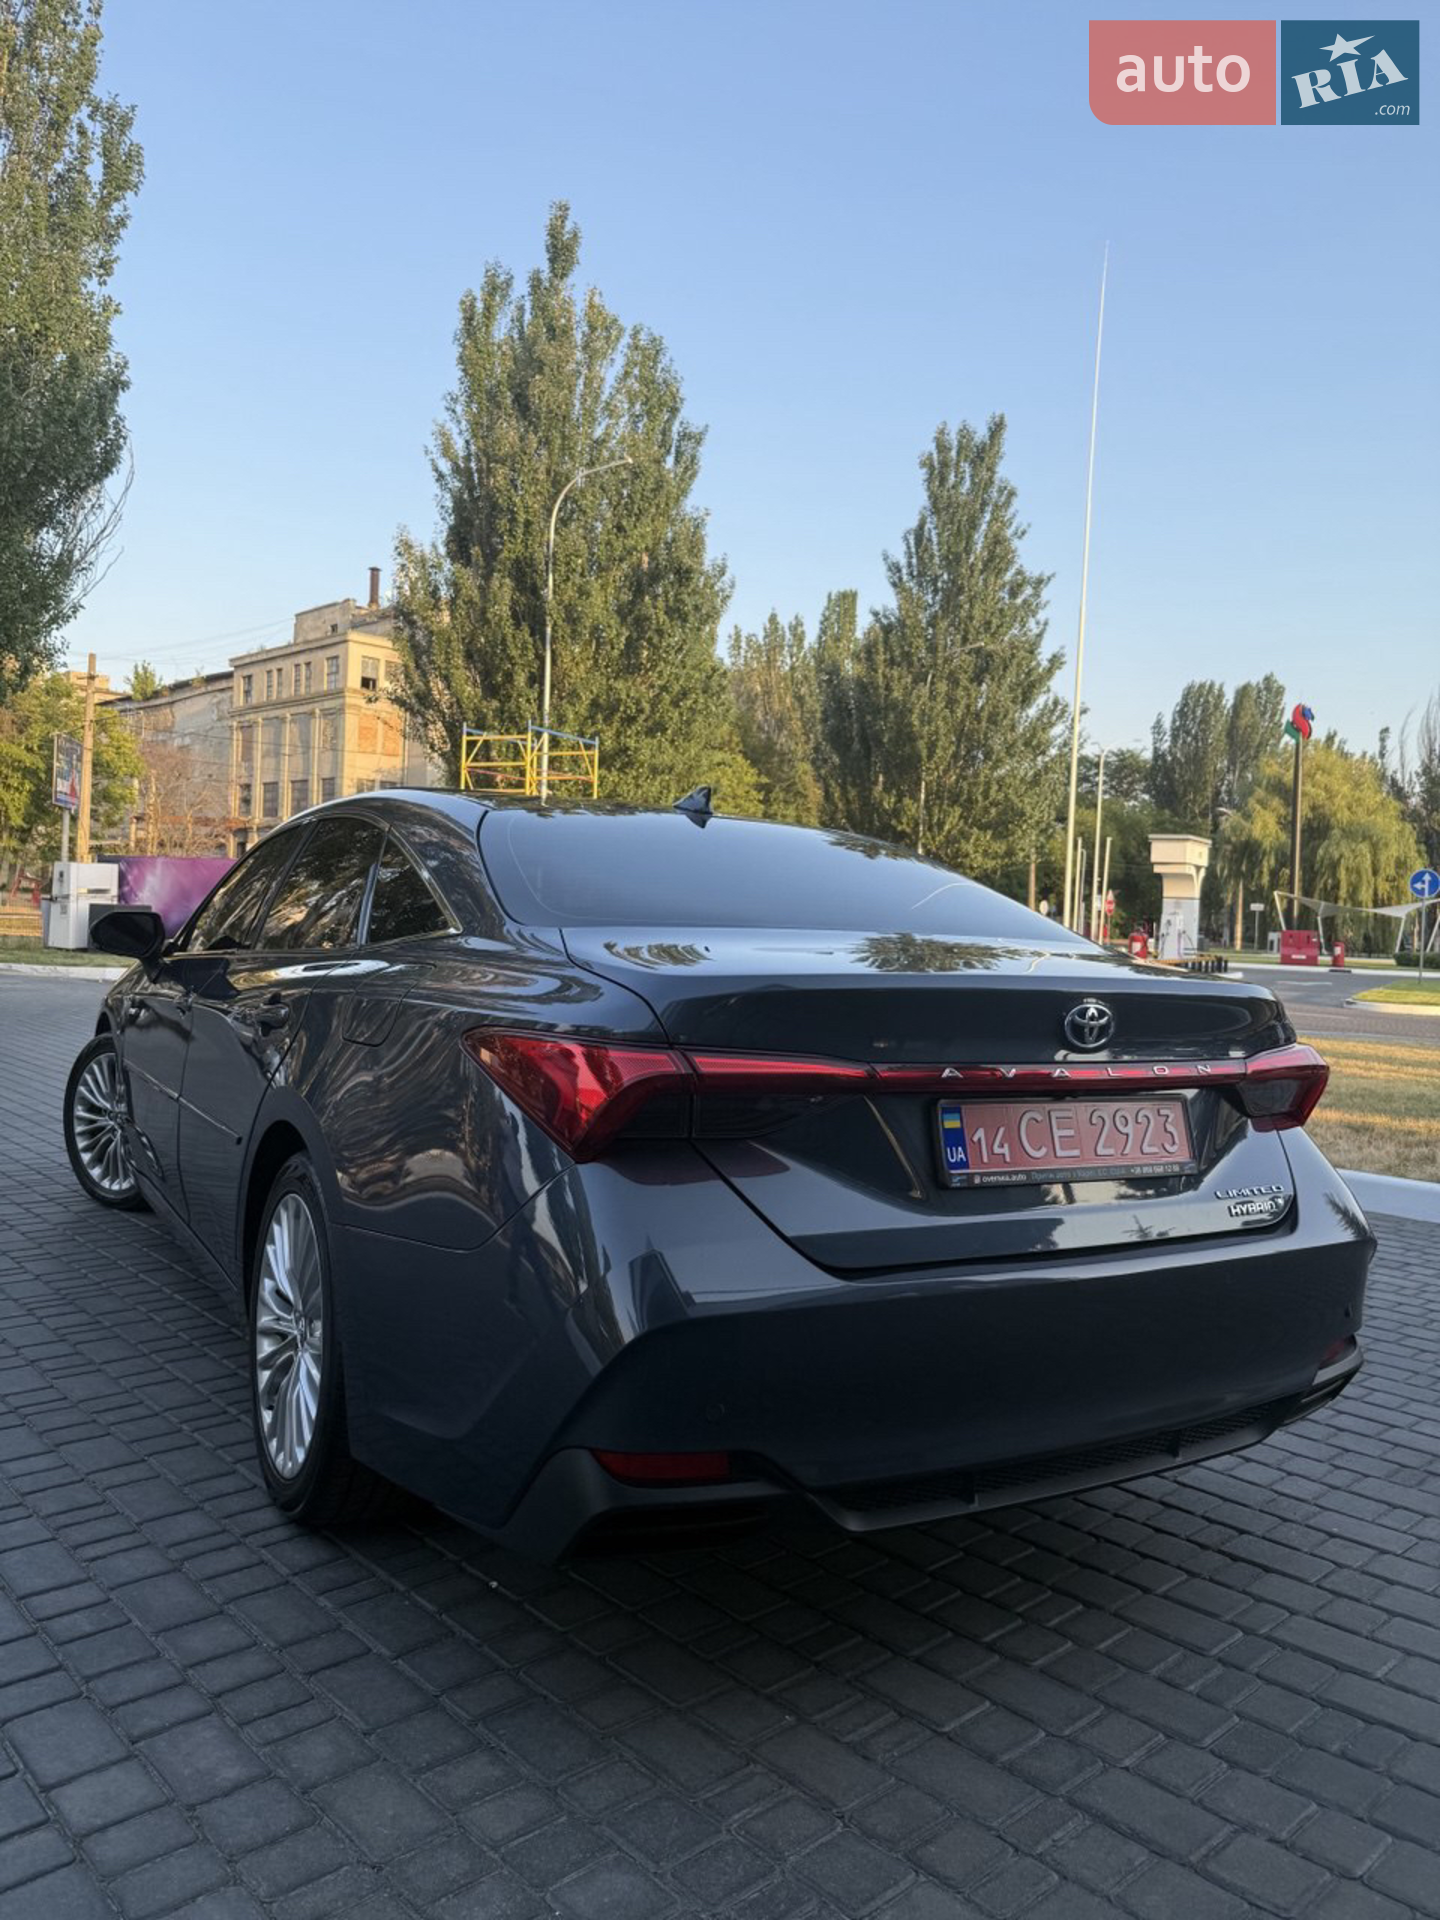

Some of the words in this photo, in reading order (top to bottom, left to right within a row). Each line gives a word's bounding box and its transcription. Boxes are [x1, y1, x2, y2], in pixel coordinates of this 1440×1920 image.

[941, 1063, 1212, 1078] AVALON
[971, 1126, 1011, 1164] 14
[1018, 1108, 1081, 1159] CE
[1089, 1106, 1180, 1157] 2923
[947, 1147, 967, 1163] UA
[1214, 1184, 1285, 1200] LIMITED
[1227, 1200, 1278, 1217] HYBRID
